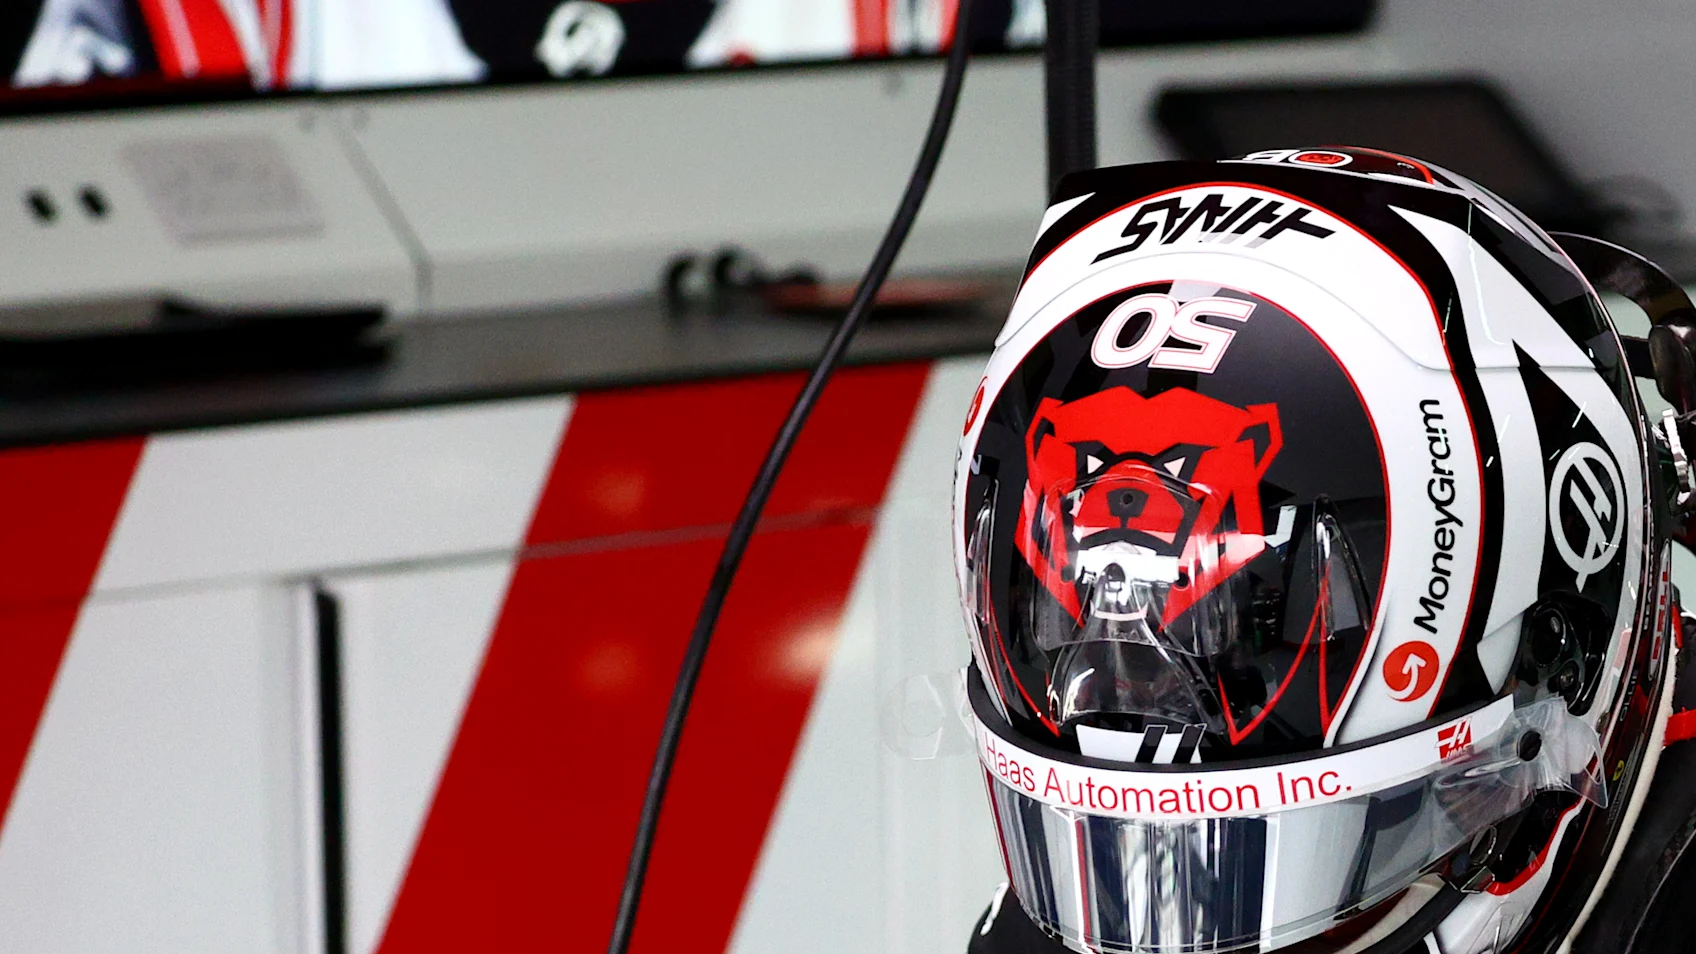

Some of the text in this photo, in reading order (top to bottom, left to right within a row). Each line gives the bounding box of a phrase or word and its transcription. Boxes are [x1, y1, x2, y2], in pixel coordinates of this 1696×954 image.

[1089, 193, 1336, 266] HAAS
[1090, 293, 1258, 374] 50
[1413, 398, 1456, 634] MoneyGram
[984, 731, 1353, 815] Haas Automation Inc.
